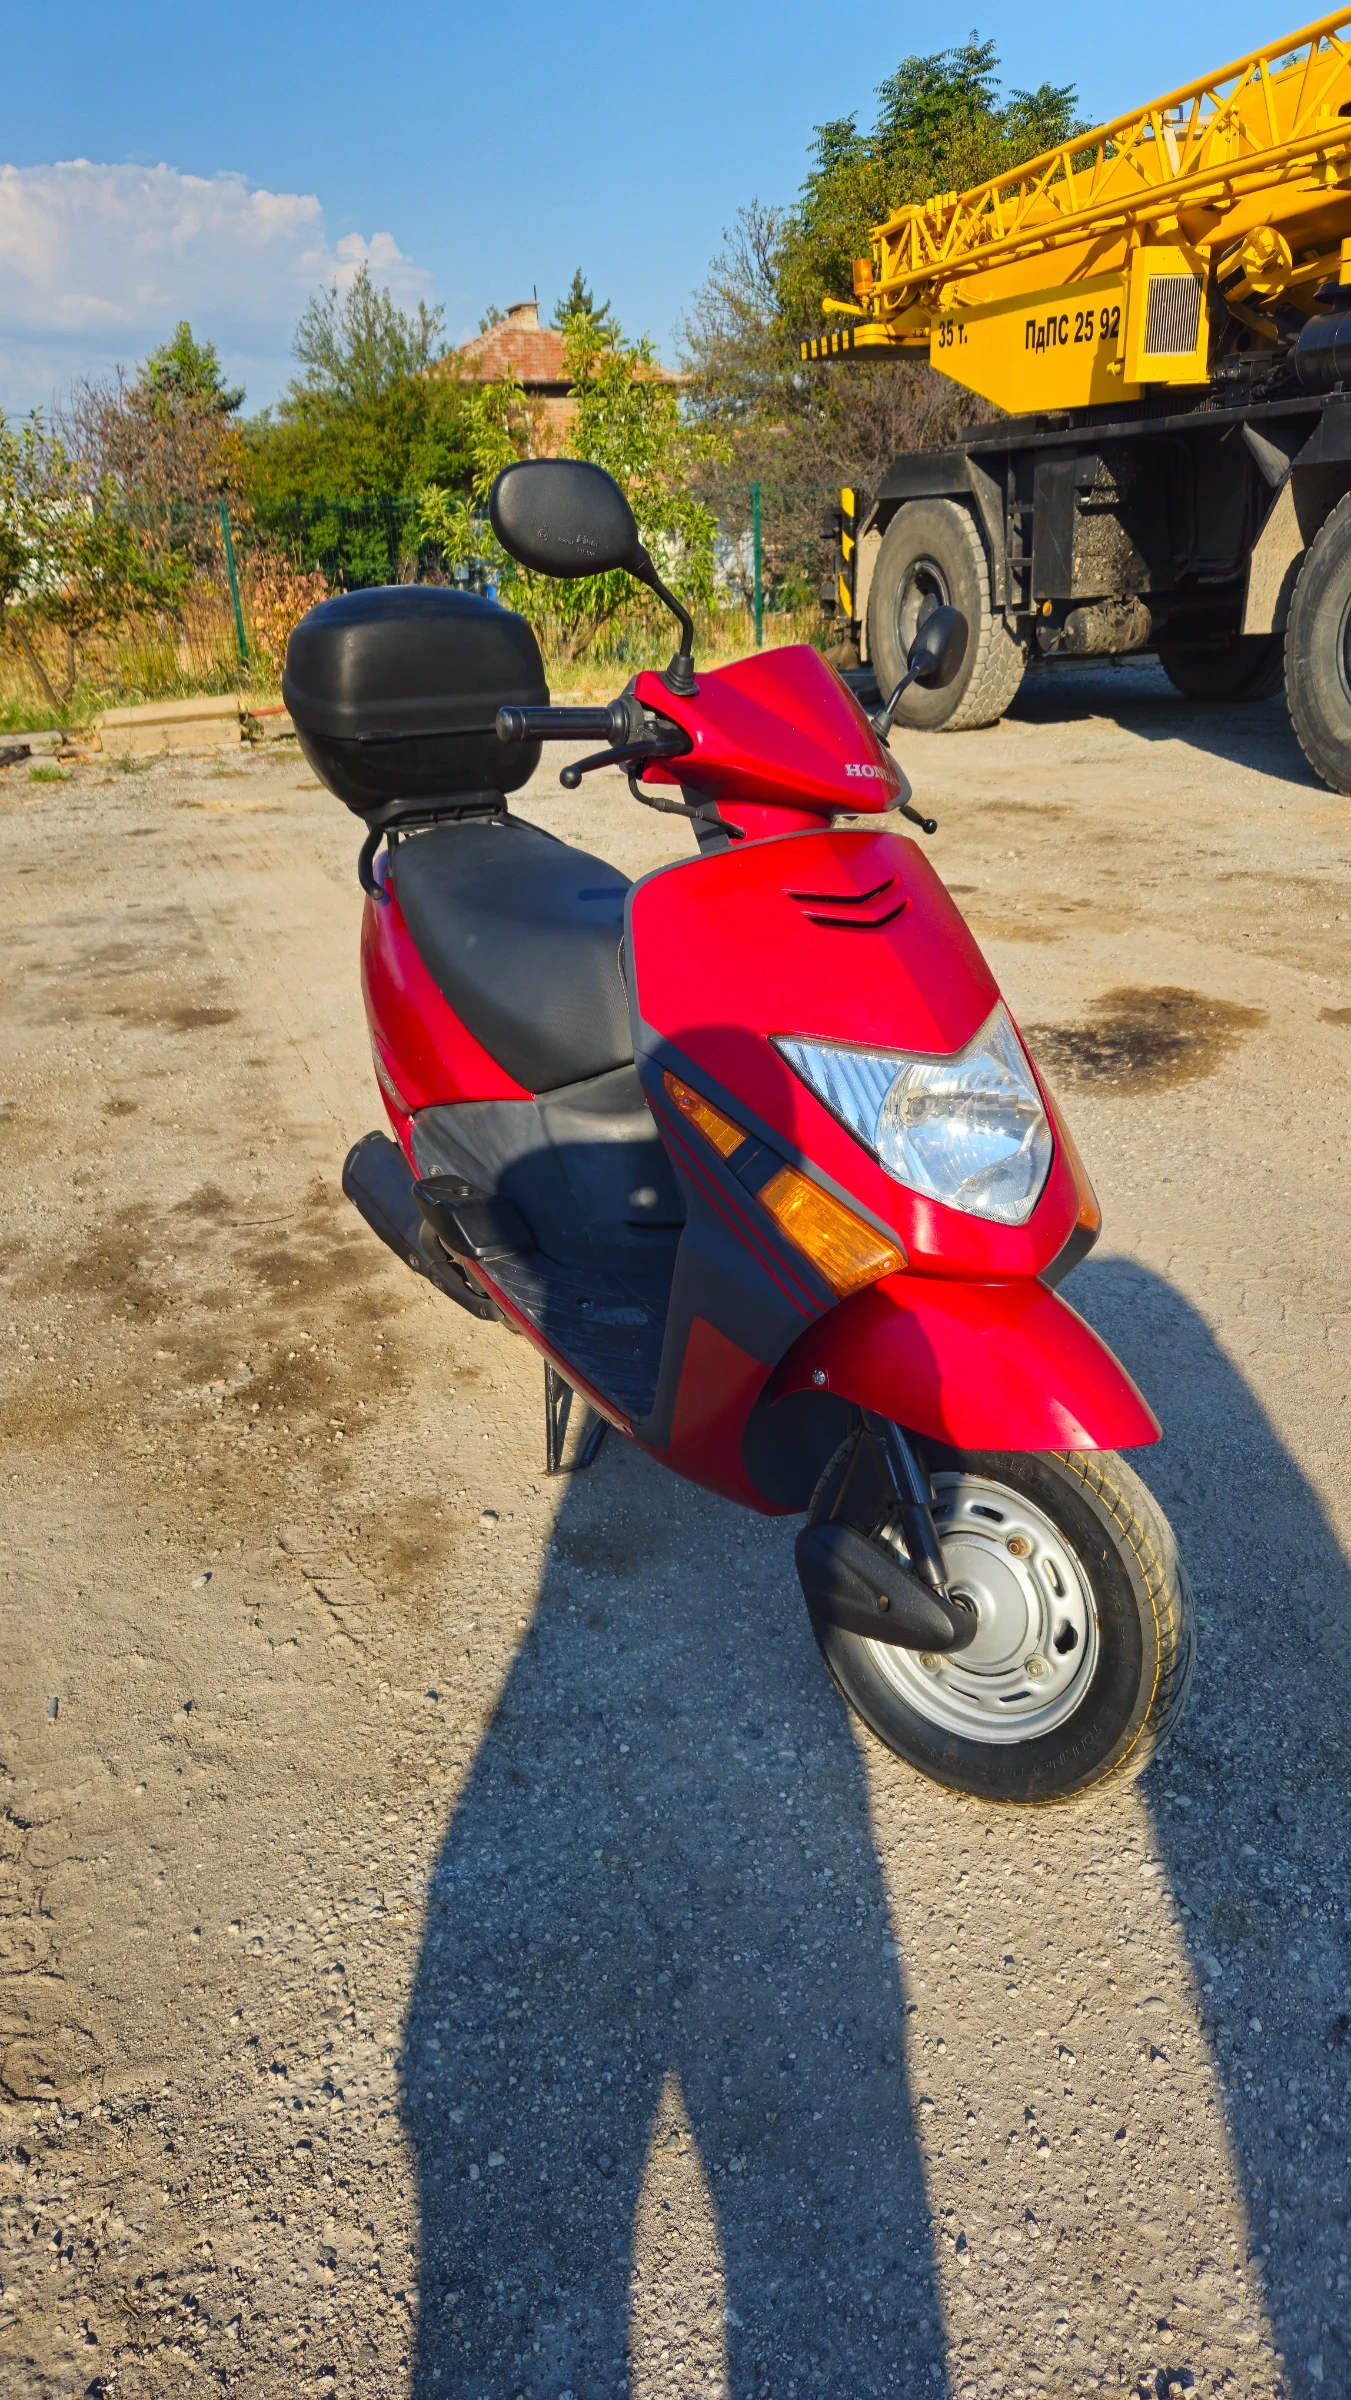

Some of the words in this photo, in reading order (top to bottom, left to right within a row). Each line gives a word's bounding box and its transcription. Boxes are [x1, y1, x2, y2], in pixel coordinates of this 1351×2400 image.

[938, 320, 953, 348] 35
[958, 325, 968, 346] т.
[1025, 314, 1069, 354] ПдПС
[1074, 310, 1095, 343] 25
[1100, 306, 1121, 340] 92
